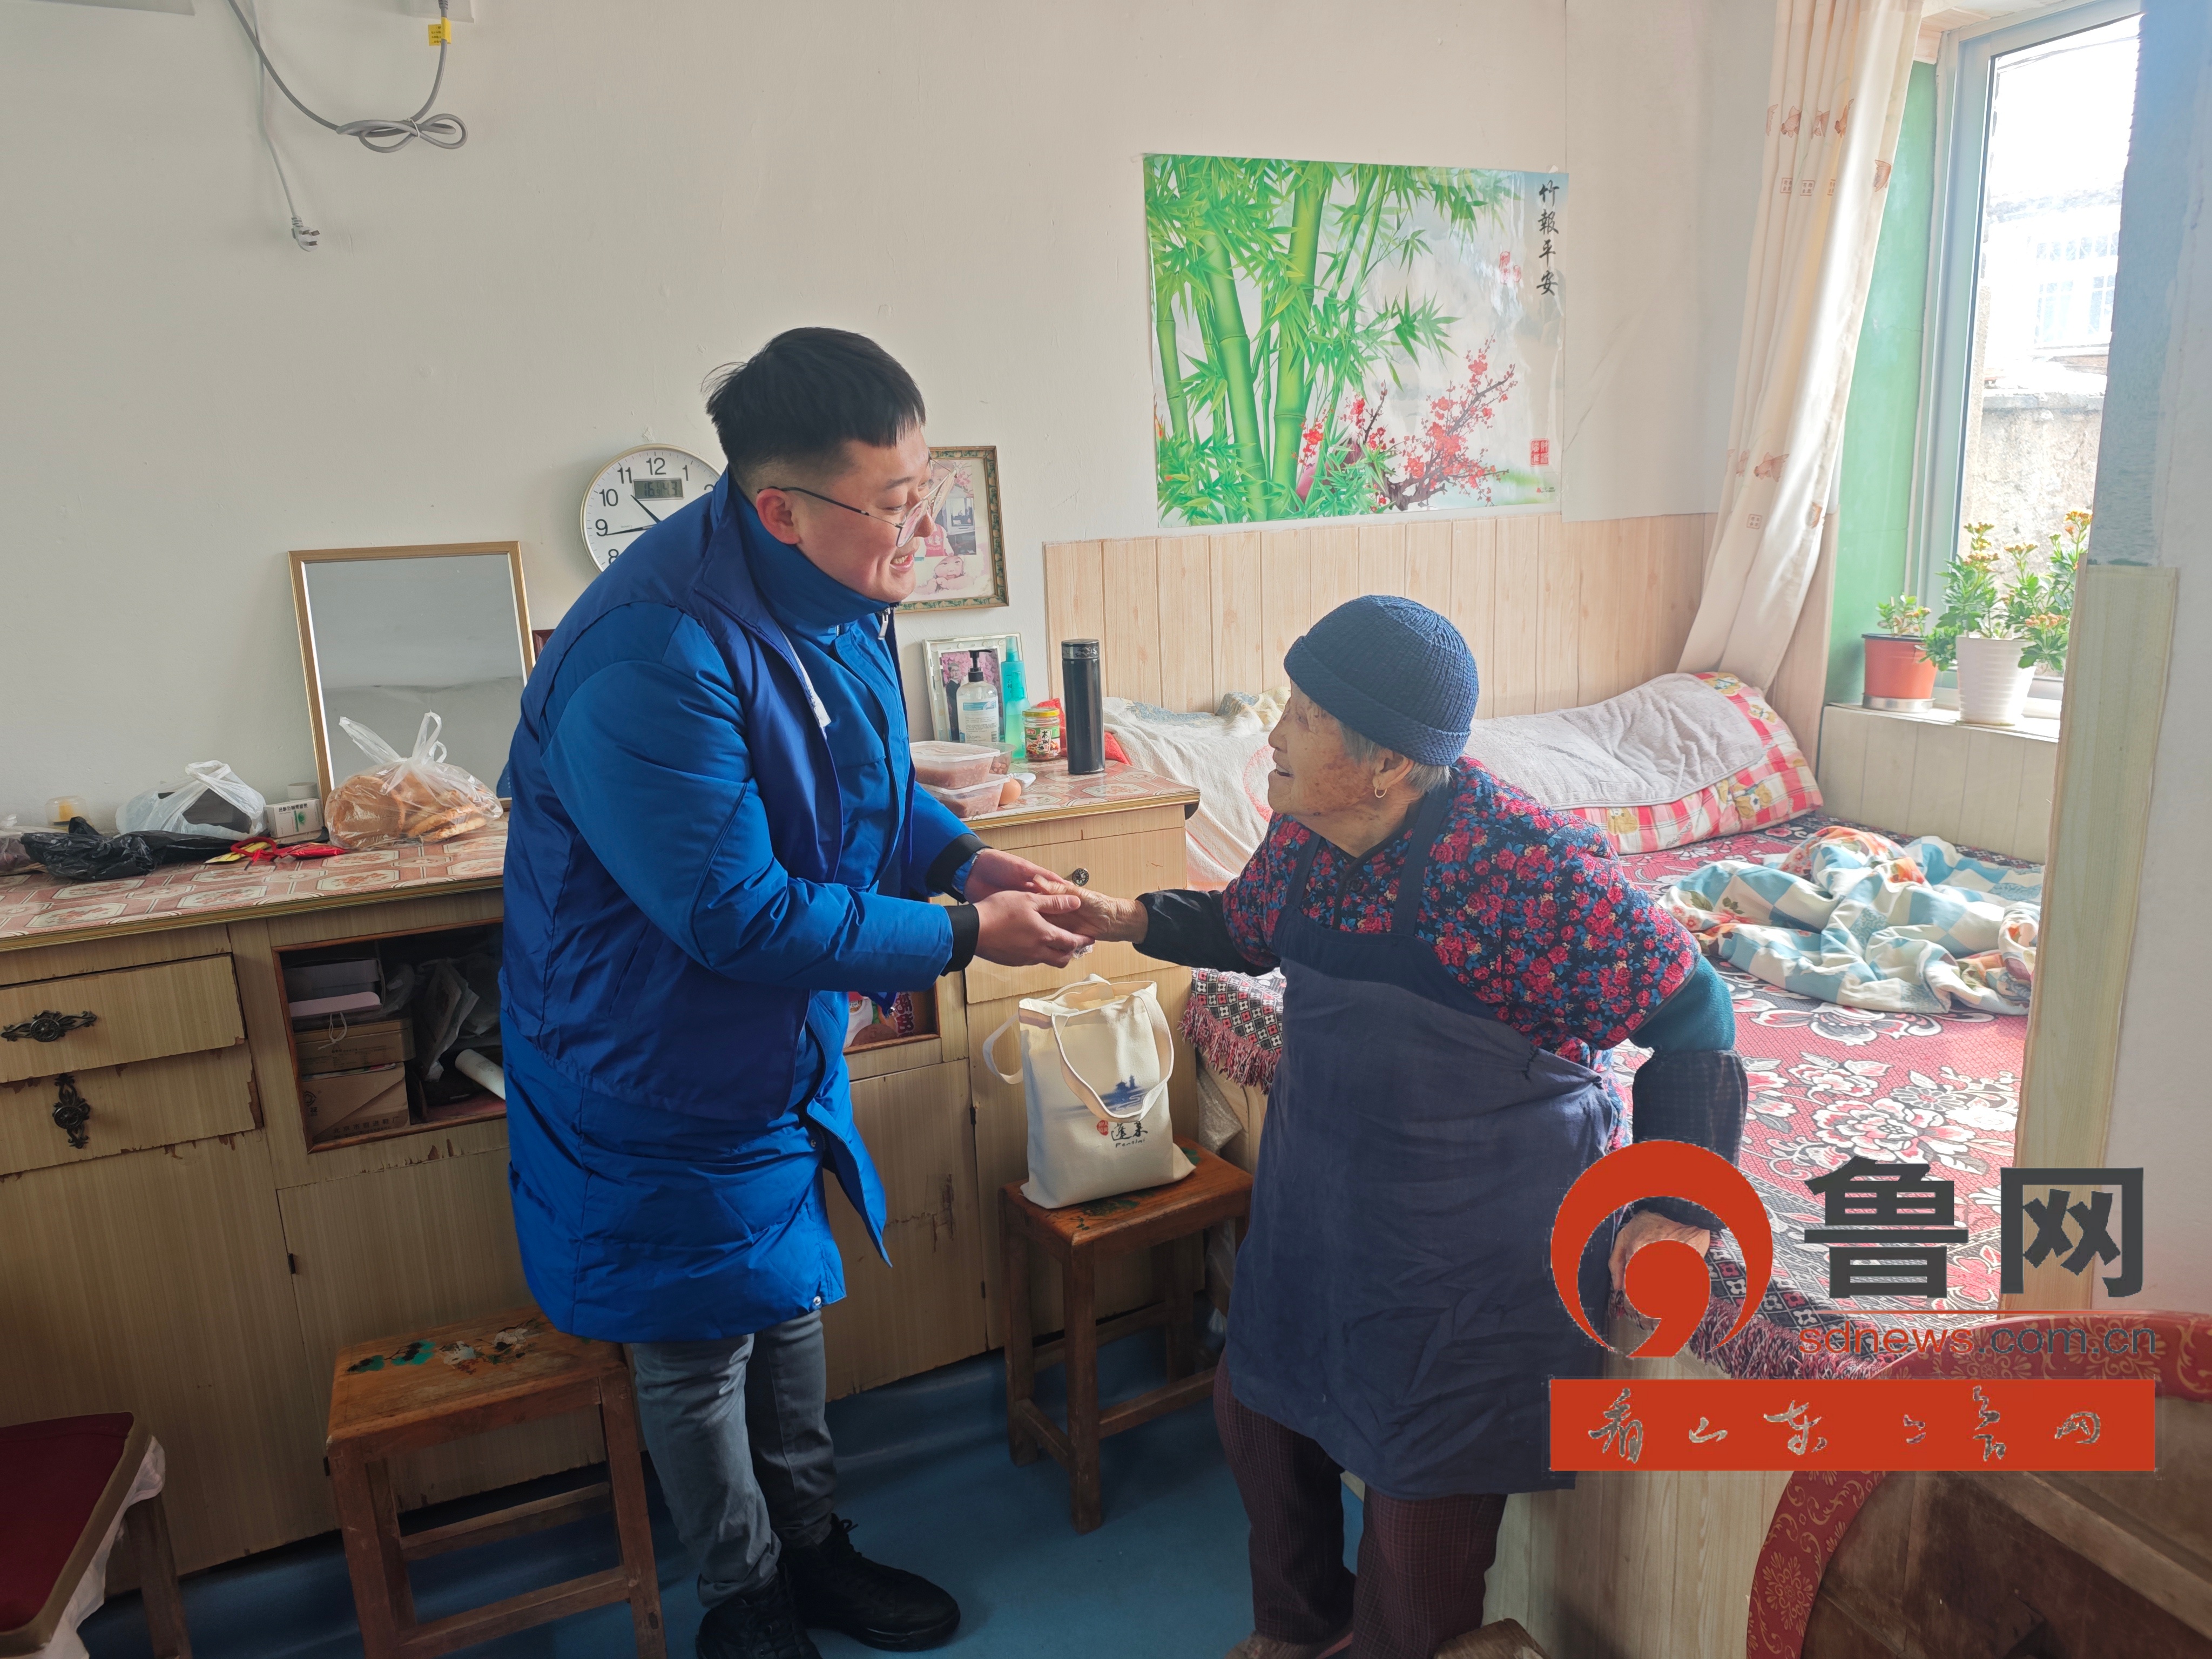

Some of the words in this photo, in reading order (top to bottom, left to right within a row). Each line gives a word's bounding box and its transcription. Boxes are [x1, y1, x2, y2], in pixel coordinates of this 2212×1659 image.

[1536, 179, 1560, 296] 竹報平安
[646, 457, 666, 475] 12
[682, 464, 689, 481] 1
[617, 467, 632, 484] 11
[599, 489, 618, 507] 10
[595, 519, 608, 536] 9
[608, 549, 619, 564] 8
